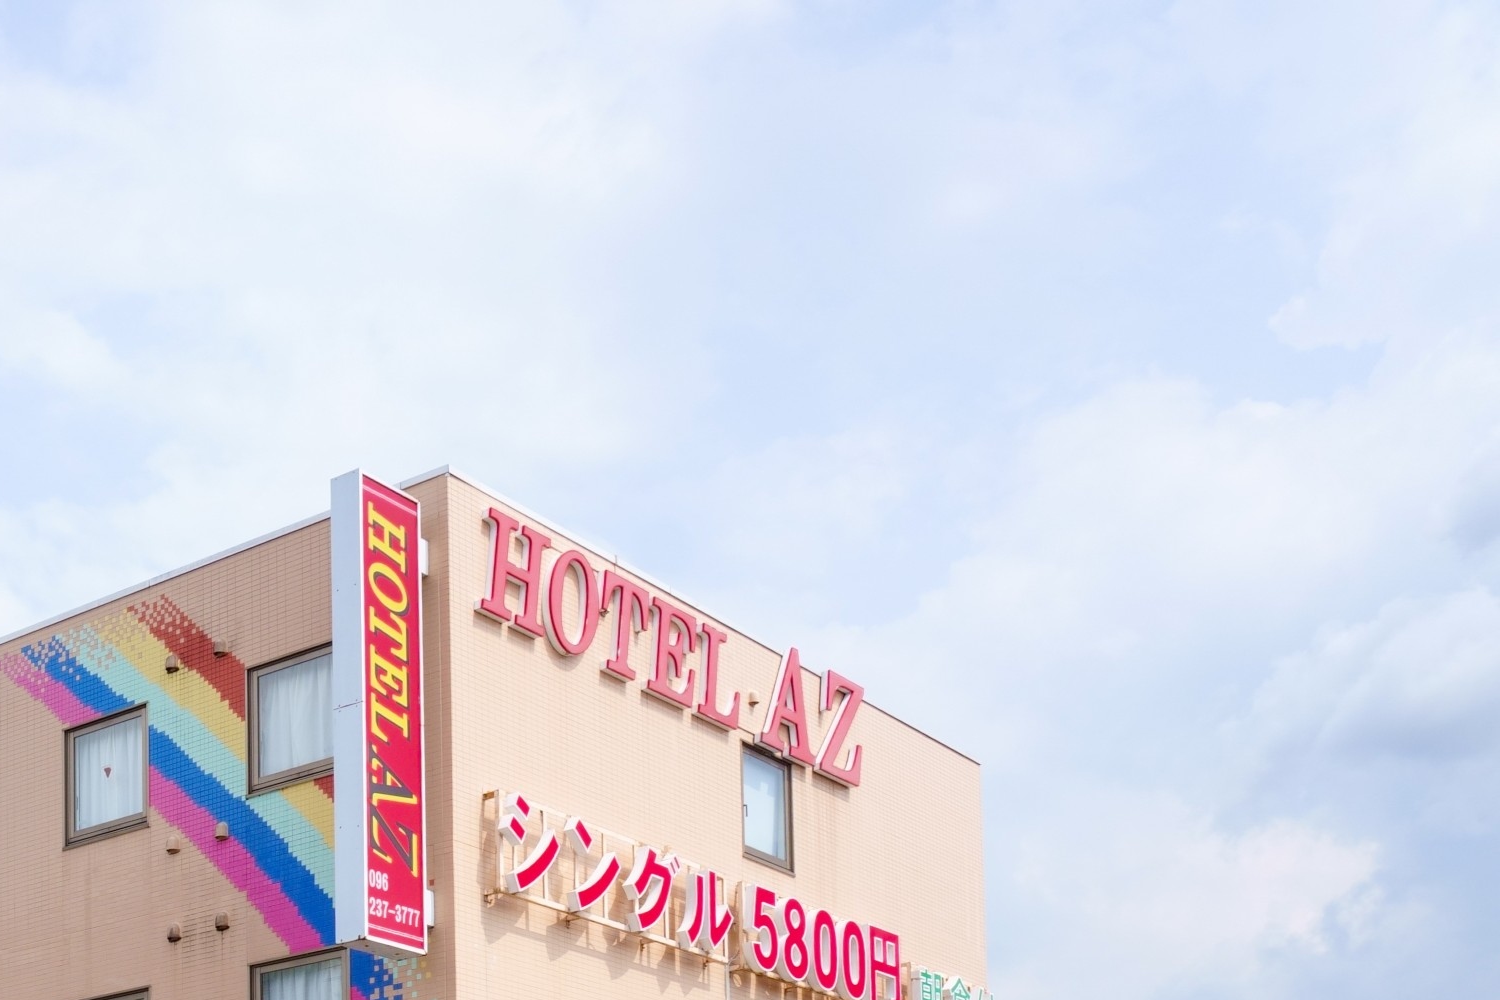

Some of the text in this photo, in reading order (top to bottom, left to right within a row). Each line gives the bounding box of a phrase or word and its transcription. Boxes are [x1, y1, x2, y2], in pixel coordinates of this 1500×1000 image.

[368, 501, 419, 878] HOTEL AZ
[474, 507, 865, 789] HOTEL AZ
[369, 869, 389, 891] 096
[369, 897, 420, 928] 237-3777
[498, 792, 735, 953] シングル
